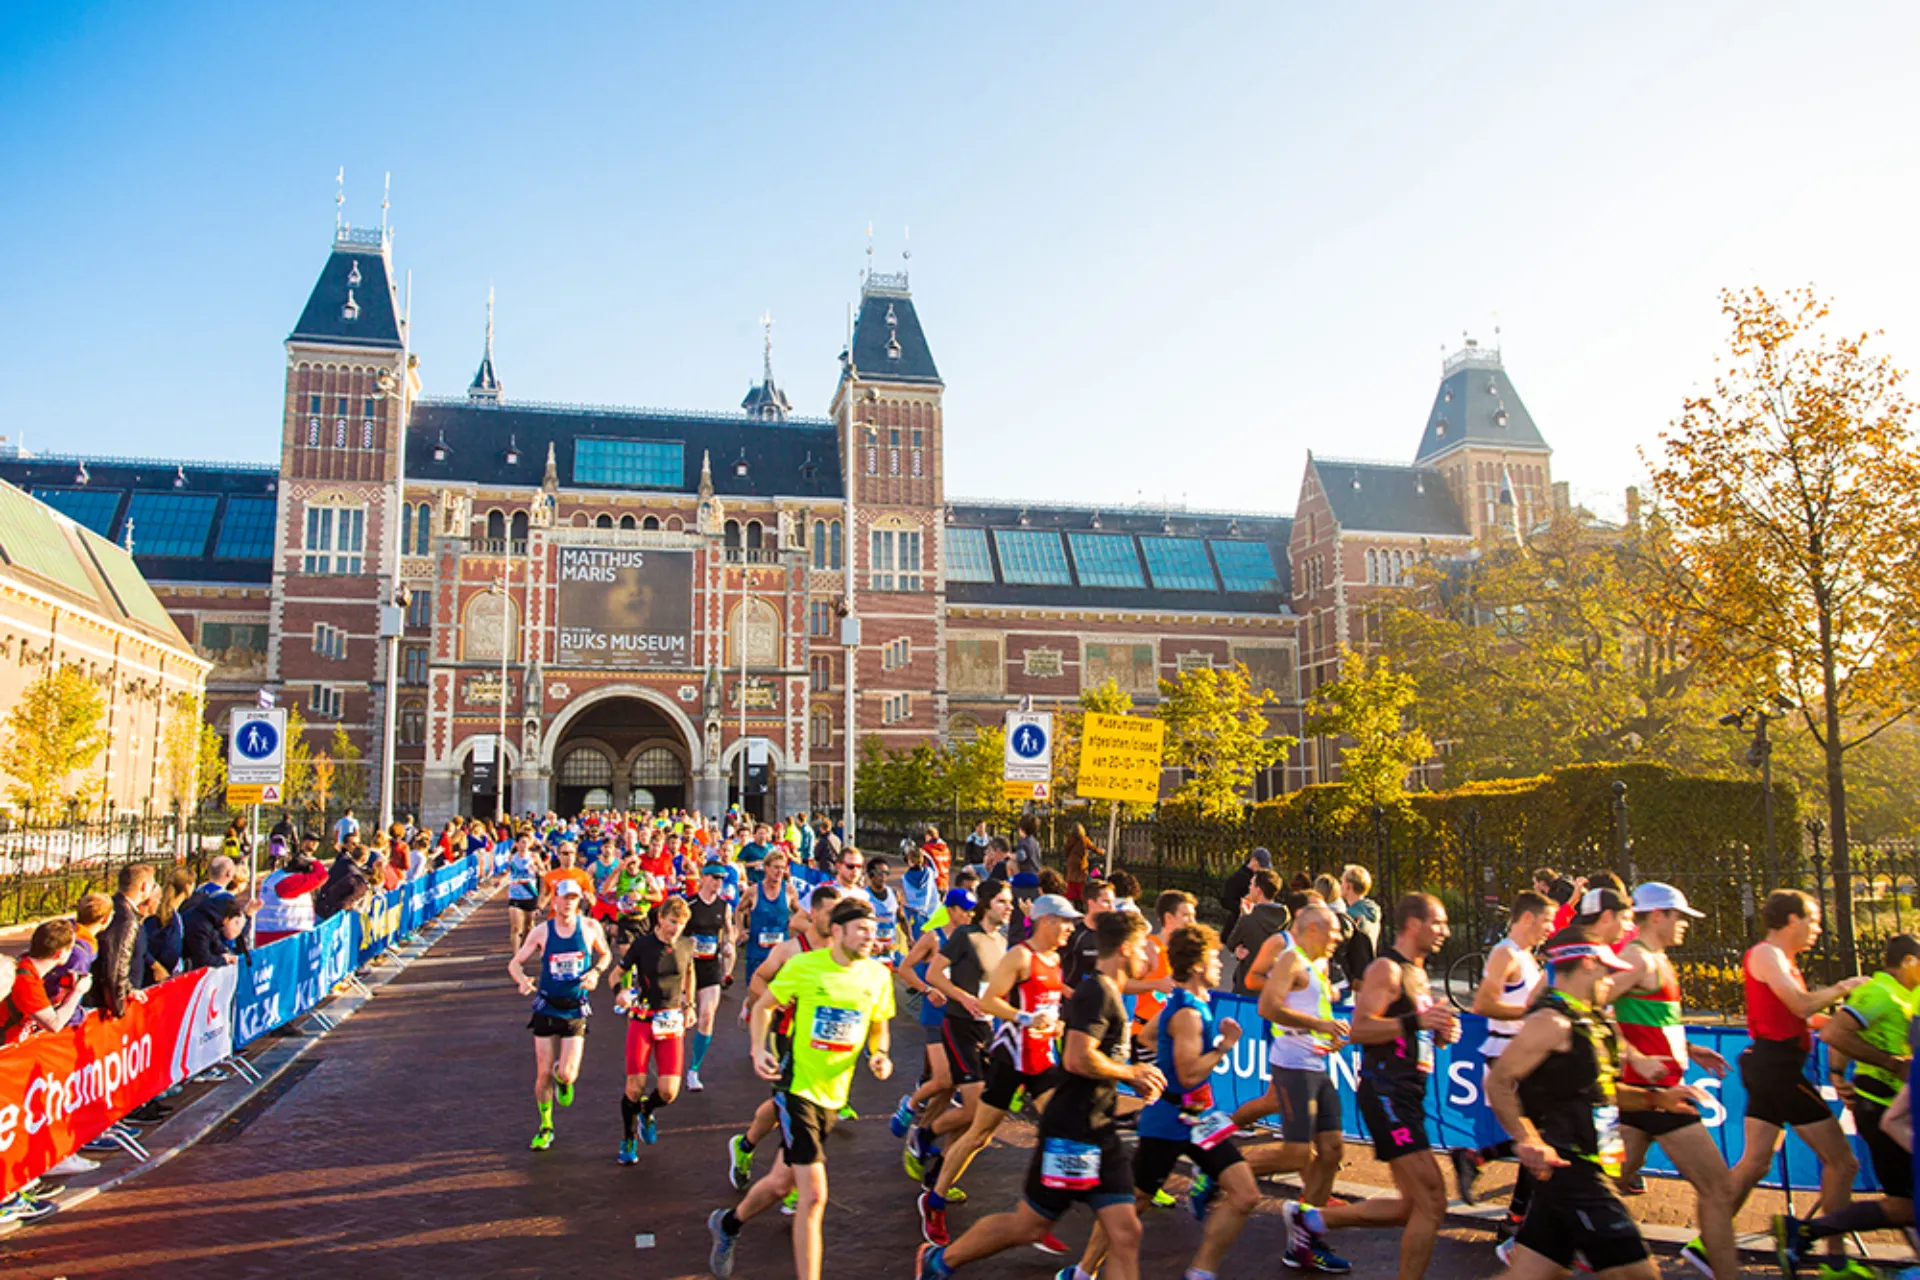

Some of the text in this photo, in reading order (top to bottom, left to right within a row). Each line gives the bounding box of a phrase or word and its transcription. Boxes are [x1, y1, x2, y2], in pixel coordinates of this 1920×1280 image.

[562, 550, 643, 568] MATTHIJS
[562, 566, 617, 582] MARIS
[610, 635, 685, 651] MUSEUM
[24, 1032, 152, 1135] Champion
